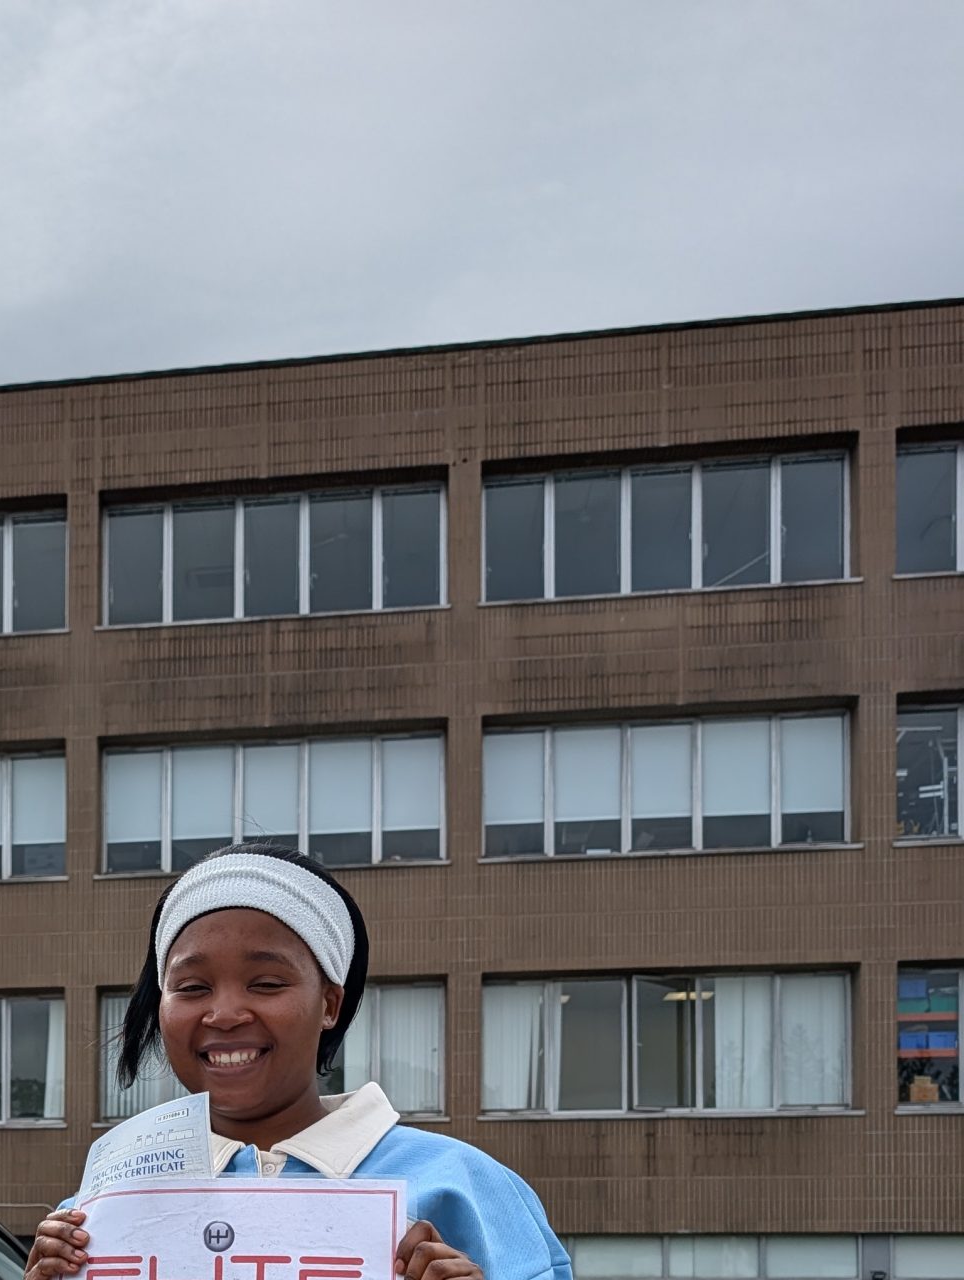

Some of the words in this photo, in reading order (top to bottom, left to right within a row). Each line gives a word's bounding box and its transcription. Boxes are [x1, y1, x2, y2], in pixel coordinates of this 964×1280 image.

[91, 1158, 133, 1184] PRACTICAL
[136, 1148, 185, 1166] DRIVING
[124, 1160, 186, 1178] CERTIFICATE
